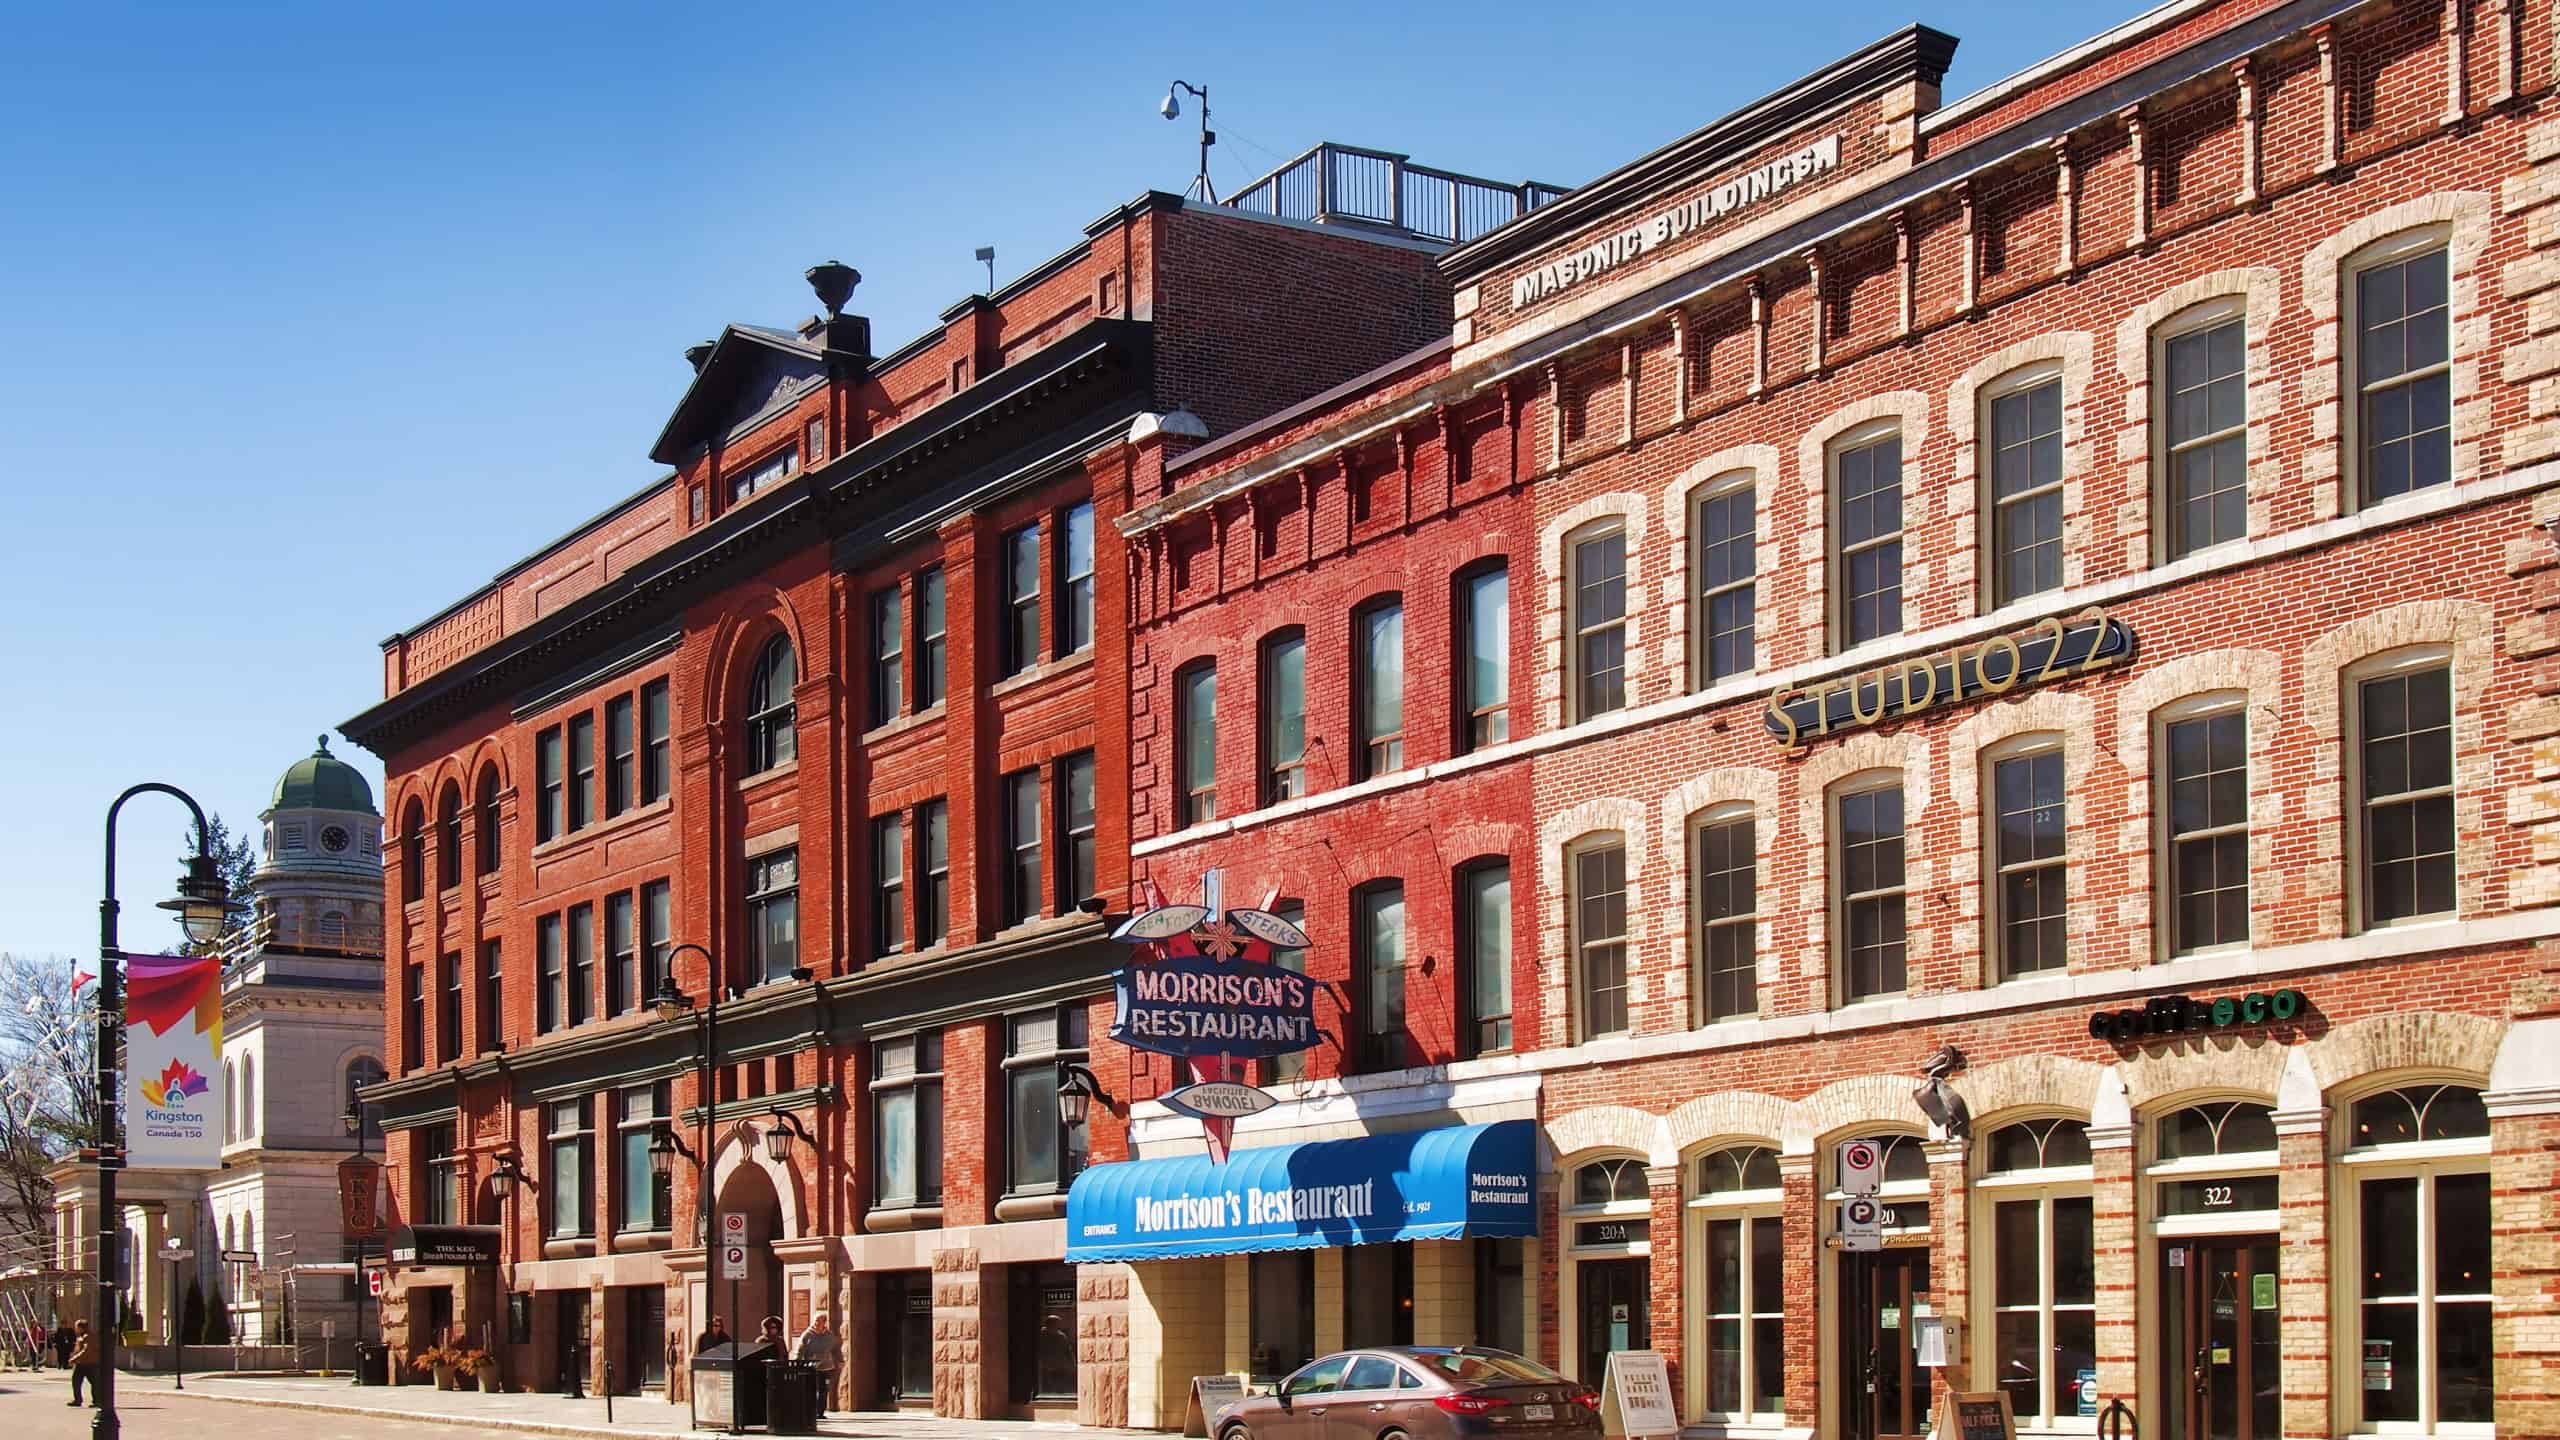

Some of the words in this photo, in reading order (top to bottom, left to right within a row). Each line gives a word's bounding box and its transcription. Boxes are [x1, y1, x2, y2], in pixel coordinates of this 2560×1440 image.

[1513, 228, 1643, 310] MASONIC
[1241, 911, 1299, 945] STEAKS
[1135, 970, 1305, 1008] MORRISON'S
[1131, 1009, 1311, 1043] RESTAURANT
[145, 1109, 203, 1123] Kingston
[146, 1129, 182, 1138] Canada
[184, 1130, 202, 1138] 150
[1472, 1173, 1527, 1187] Morrison's
[1471, 1189, 1529, 1204] Restaurant
[2204, 1186, 2233, 1205] 322
[1084, 1224, 1118, 1237] ENTRANCE
[1135, 1189, 1241, 1233] Morrison's
[1247, 1177, 1374, 1226] Restaurant
[1880, 1209, 1895, 1225] 20
[456, 1245, 476, 1253] KEG
